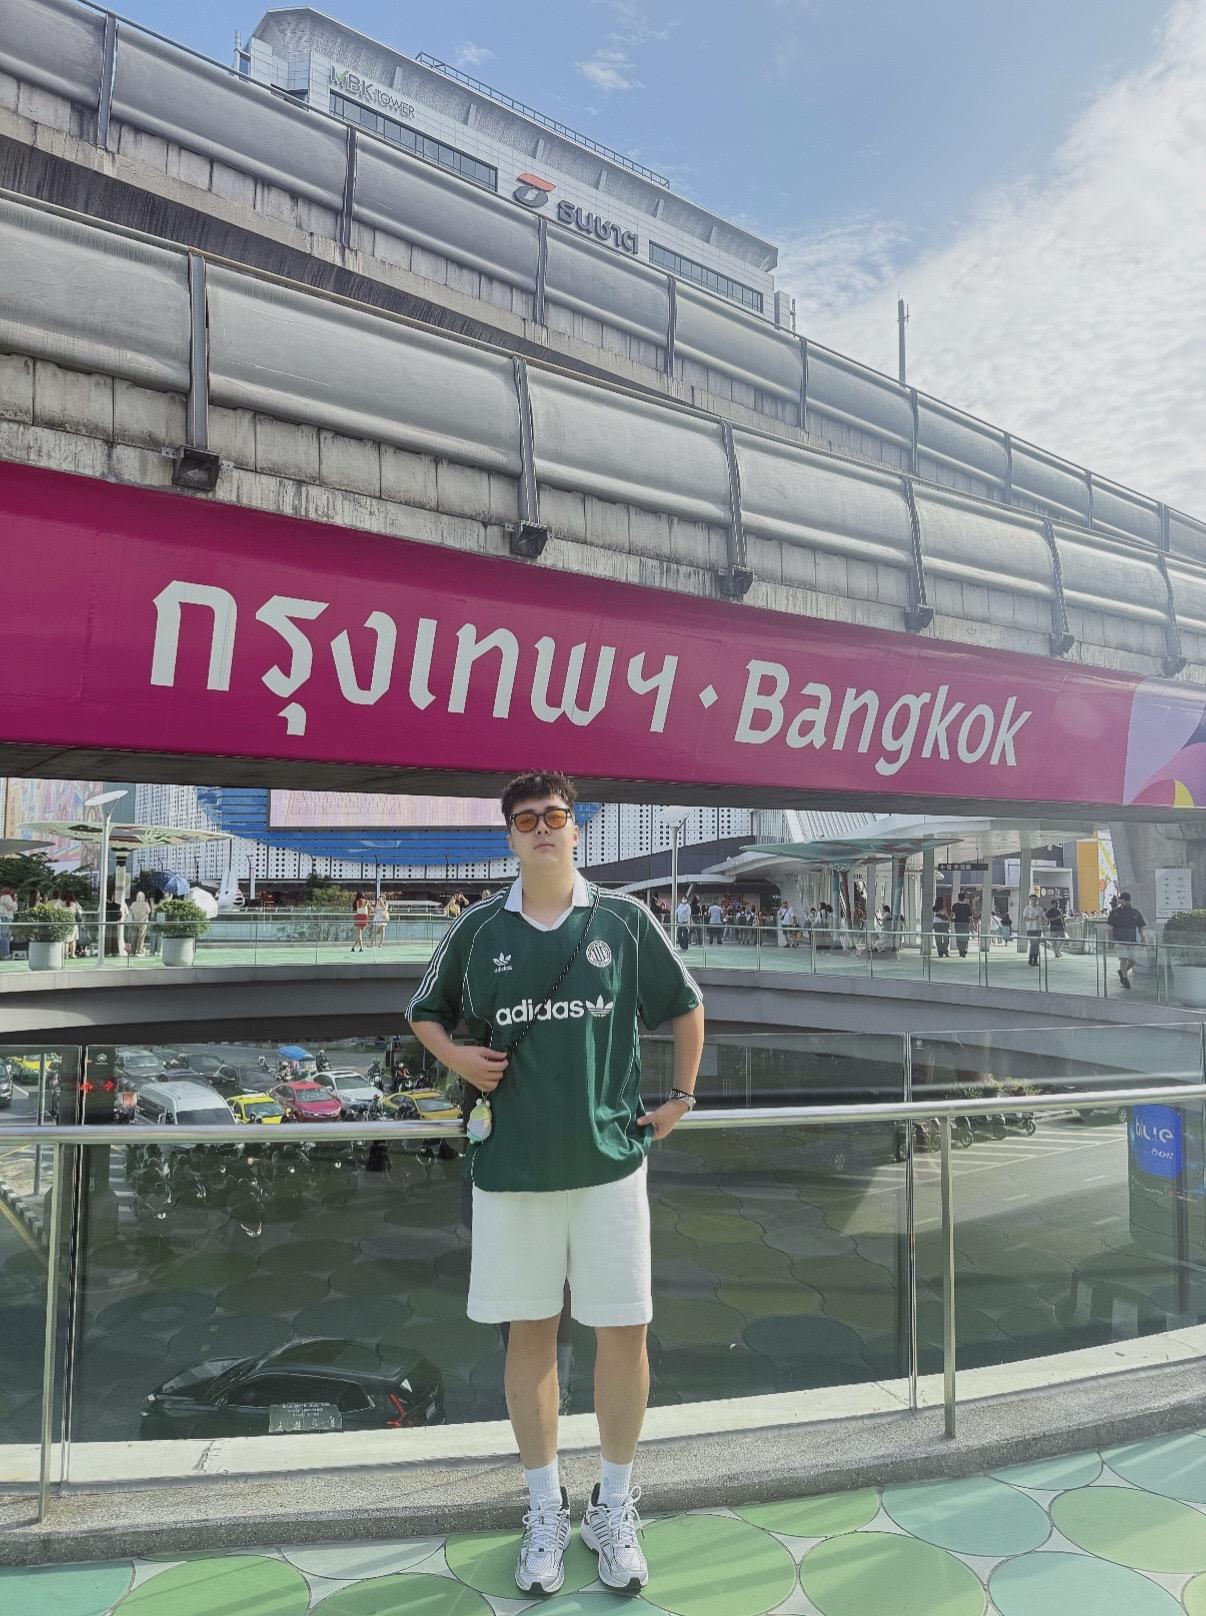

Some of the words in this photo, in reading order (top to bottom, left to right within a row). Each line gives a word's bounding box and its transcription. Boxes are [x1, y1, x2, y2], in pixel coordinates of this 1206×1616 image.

[330, 65, 374, 101] MBK
[375, 88, 416, 119] TOWER
[558, 199, 639, 254] ธนชาต
[150, 579, 680, 737] กรุงเทพฯ
[734, 658, 1033, 777] Bangkok
[495, 998, 585, 1026] adidas
